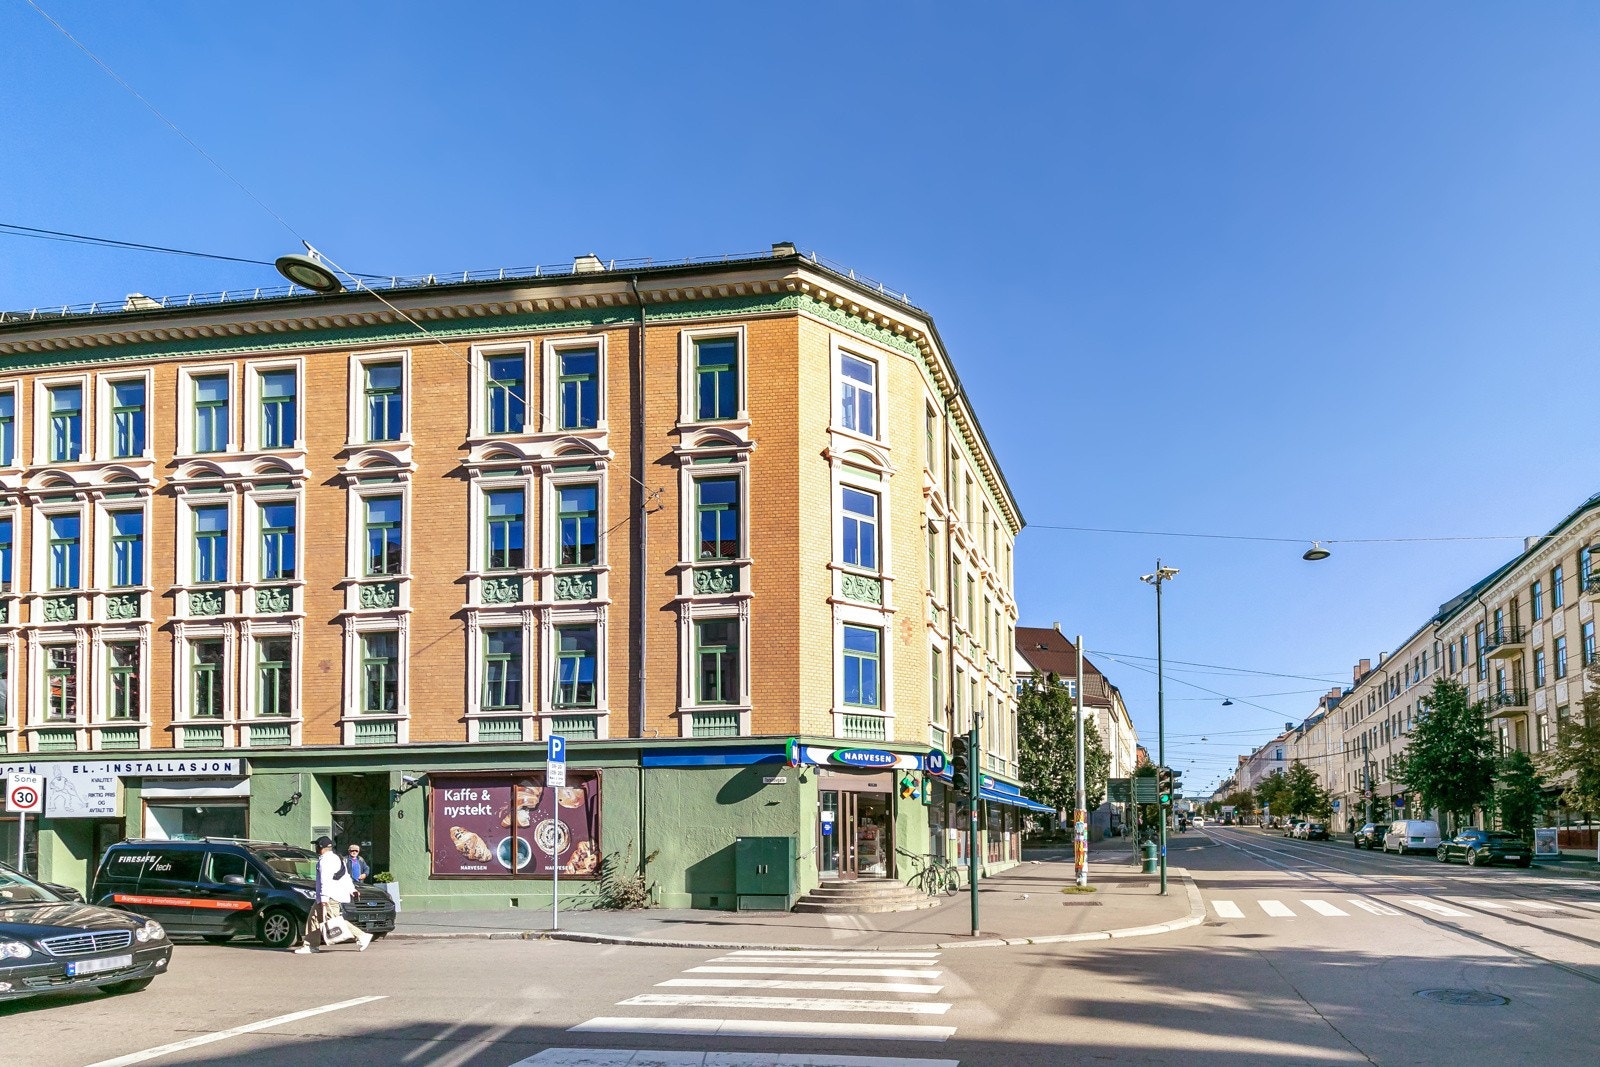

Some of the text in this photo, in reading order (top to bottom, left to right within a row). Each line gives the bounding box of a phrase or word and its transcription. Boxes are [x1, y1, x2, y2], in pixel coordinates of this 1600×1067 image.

[552, 738, 562, 759] P
[844, 752, 892, 763] NARVESEN
[930, 755, 942, 768] N
[15, 775, 37, 784] Sone
[17, 792, 34, 803] 30
[444, 788, 491, 801] Kaffe &
[397, 809, 404, 820] 6
[444, 802, 492, 818] nystekt
[118, 855, 156, 863] FIRESAFE
[155, 863, 172, 871] tech
